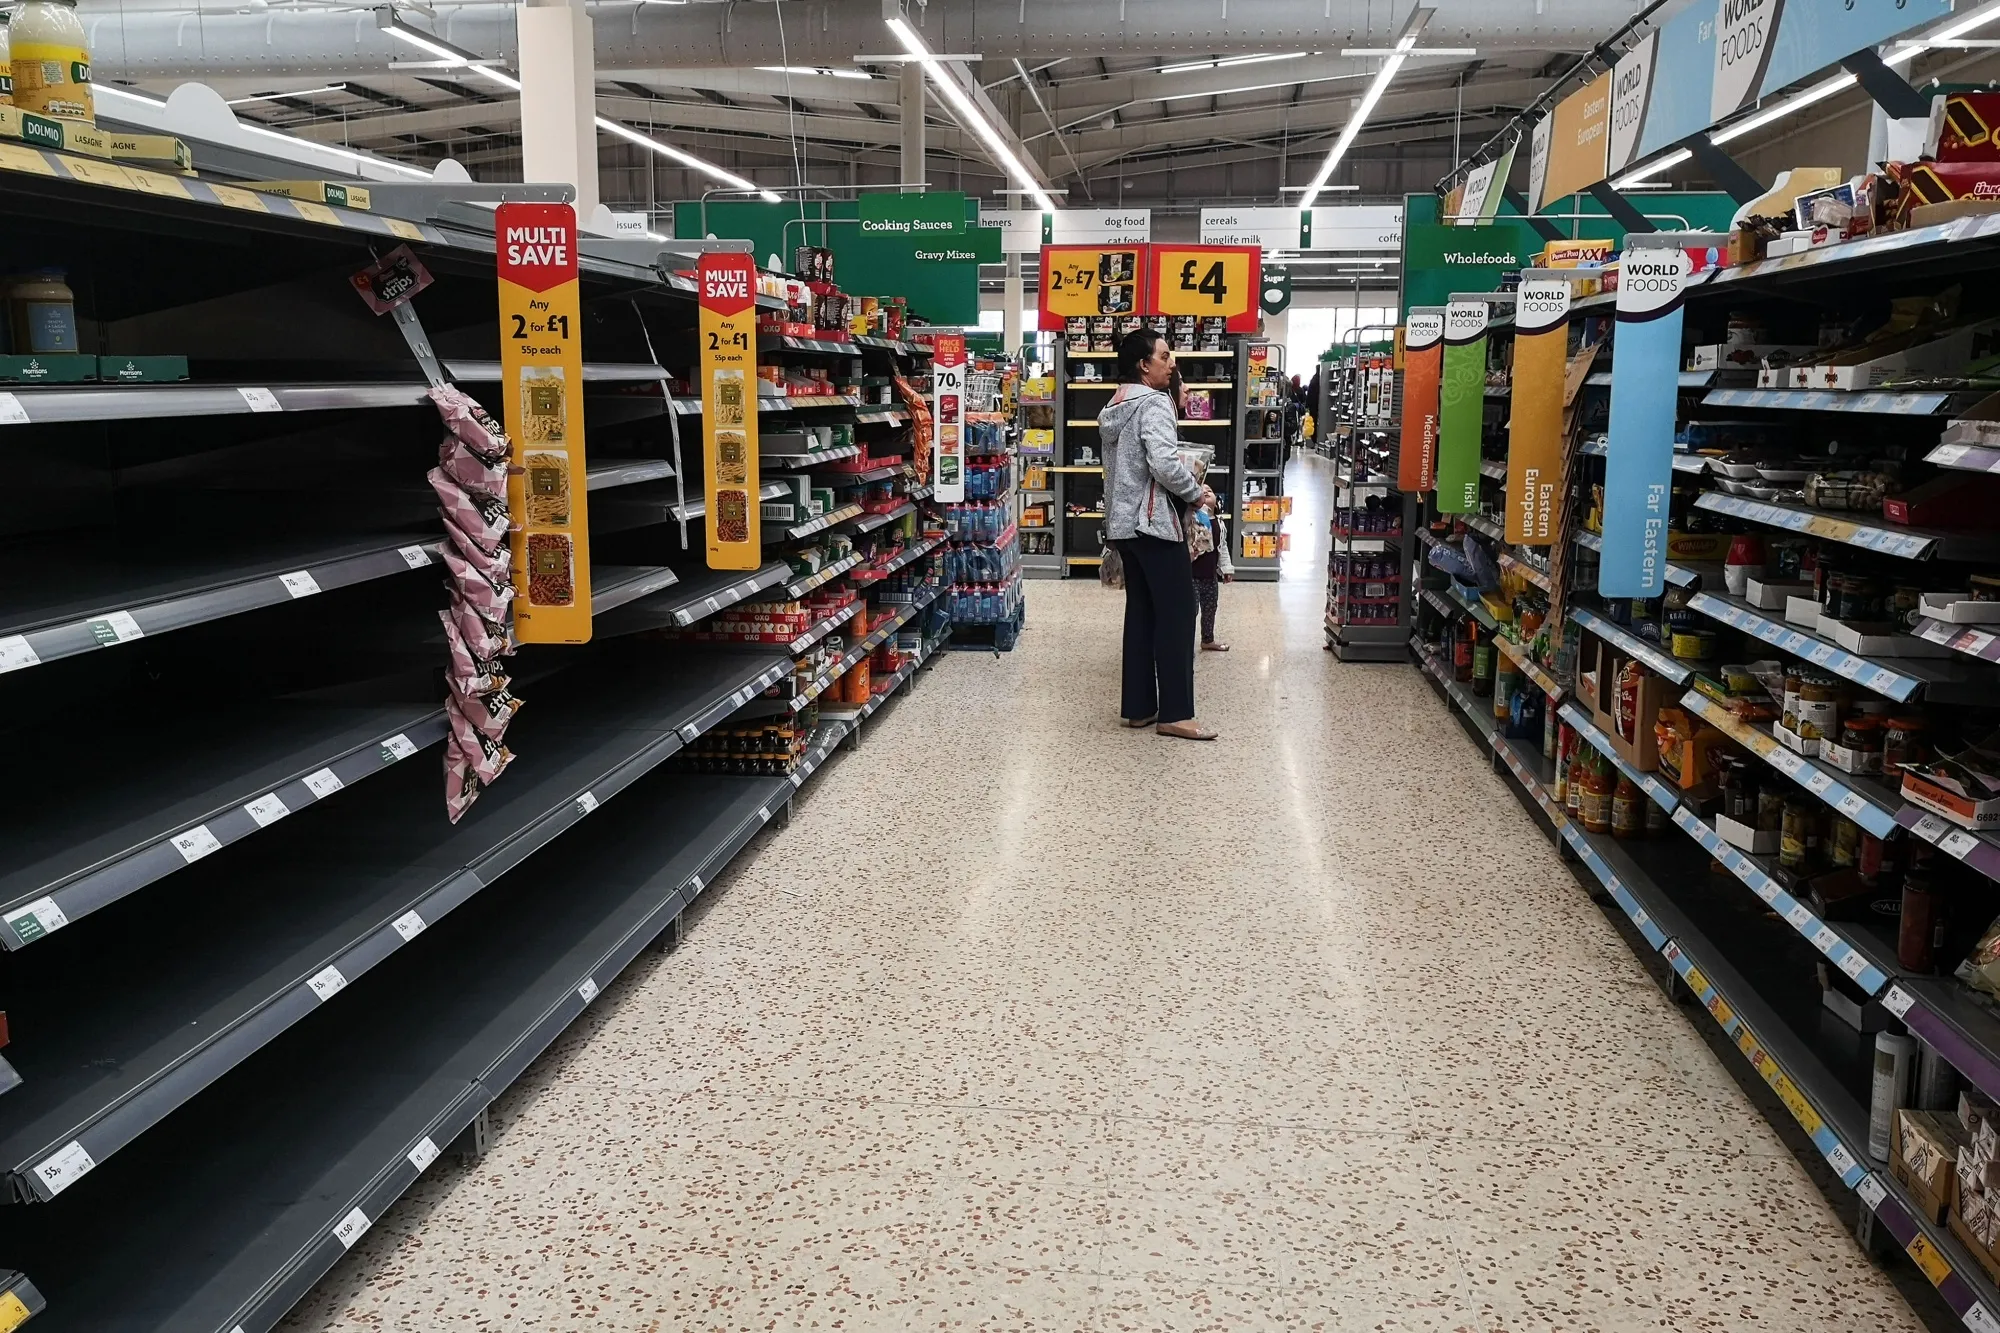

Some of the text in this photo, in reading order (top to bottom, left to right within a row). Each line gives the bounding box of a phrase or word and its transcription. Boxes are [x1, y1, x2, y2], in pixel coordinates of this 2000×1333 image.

[1721, 16, 1763, 71] FOODS
[1616, 63, 1642, 100] WORLD
[1584, 96, 1605, 120] Eastern
[1615, 94, 1640, 133] FOODS
[28, 121, 59, 143] DOLMIO
[1577, 121, 1604, 146] European
[75, 135, 103, 149] LASAGNE
[1532, 133, 1545, 159] WORLD
[327, 187, 345, 200] DOLMIO
[1467, 177, 1487, 196] WORLD
[350, 194, 367, 204] LASAGNE
[862, 219, 953, 233] Cooking Sauces
[1105, 217, 1145, 228] dog food
[1205, 216, 1238, 225] cereals
[506, 227, 566, 244] MULTI
[1303, 224, 1309, 233] 8
[1123, 236, 1145, 244] food
[1204, 235, 1261, 244] longlife milk
[508, 245, 568, 266] SAVE
[915, 250, 976, 261] Gravy Mixes
[1443, 252, 1516, 264] Wholefoods
[705, 270, 747, 282] MULTI
[1627, 264, 1679, 276] WORLD
[1052, 270, 1095, 290] 2 for £7
[1180, 260, 1227, 304] £4
[1263, 274, 1285, 284] Sugar
[1626, 279, 1678, 292] FOODS
[382, 273, 414, 300] strips
[706, 283, 748, 298] SAVE
[1524, 291, 1565, 300] WORLD
[529, 300, 550, 312] Any
[1523, 302, 1564, 312] FOODS
[1451, 310, 1484, 318] WORLD
[511, 314, 569, 340] 2 for £1
[720, 322, 735, 330] Any
[1450, 319, 1483, 328] FOODS
[1410, 329, 1438, 337] FOODS
[708, 332, 720, 350] 2
[733, 332, 748, 350] £1
[939, 339, 960, 347] PRICE
[521, 346, 562, 356] 55p each
[937, 372, 962, 389] 70p
[1421, 414, 1434, 488] Mediterranean
[1464, 483, 1476, 508] Irish
[1520, 469, 1539, 537] European
[1538, 484, 1554, 537] Eastern
[1641, 484, 1665, 588] Far Eastern
[252, 806, 266, 815] 75p
[179, 839, 195, 850] 80p
[314, 981, 326, 990] 55p
[44, 1166, 63, 1180] 55p
[339, 1223, 353, 1238] £1.50
[1972, 1307, 1983, 1321] 75p
